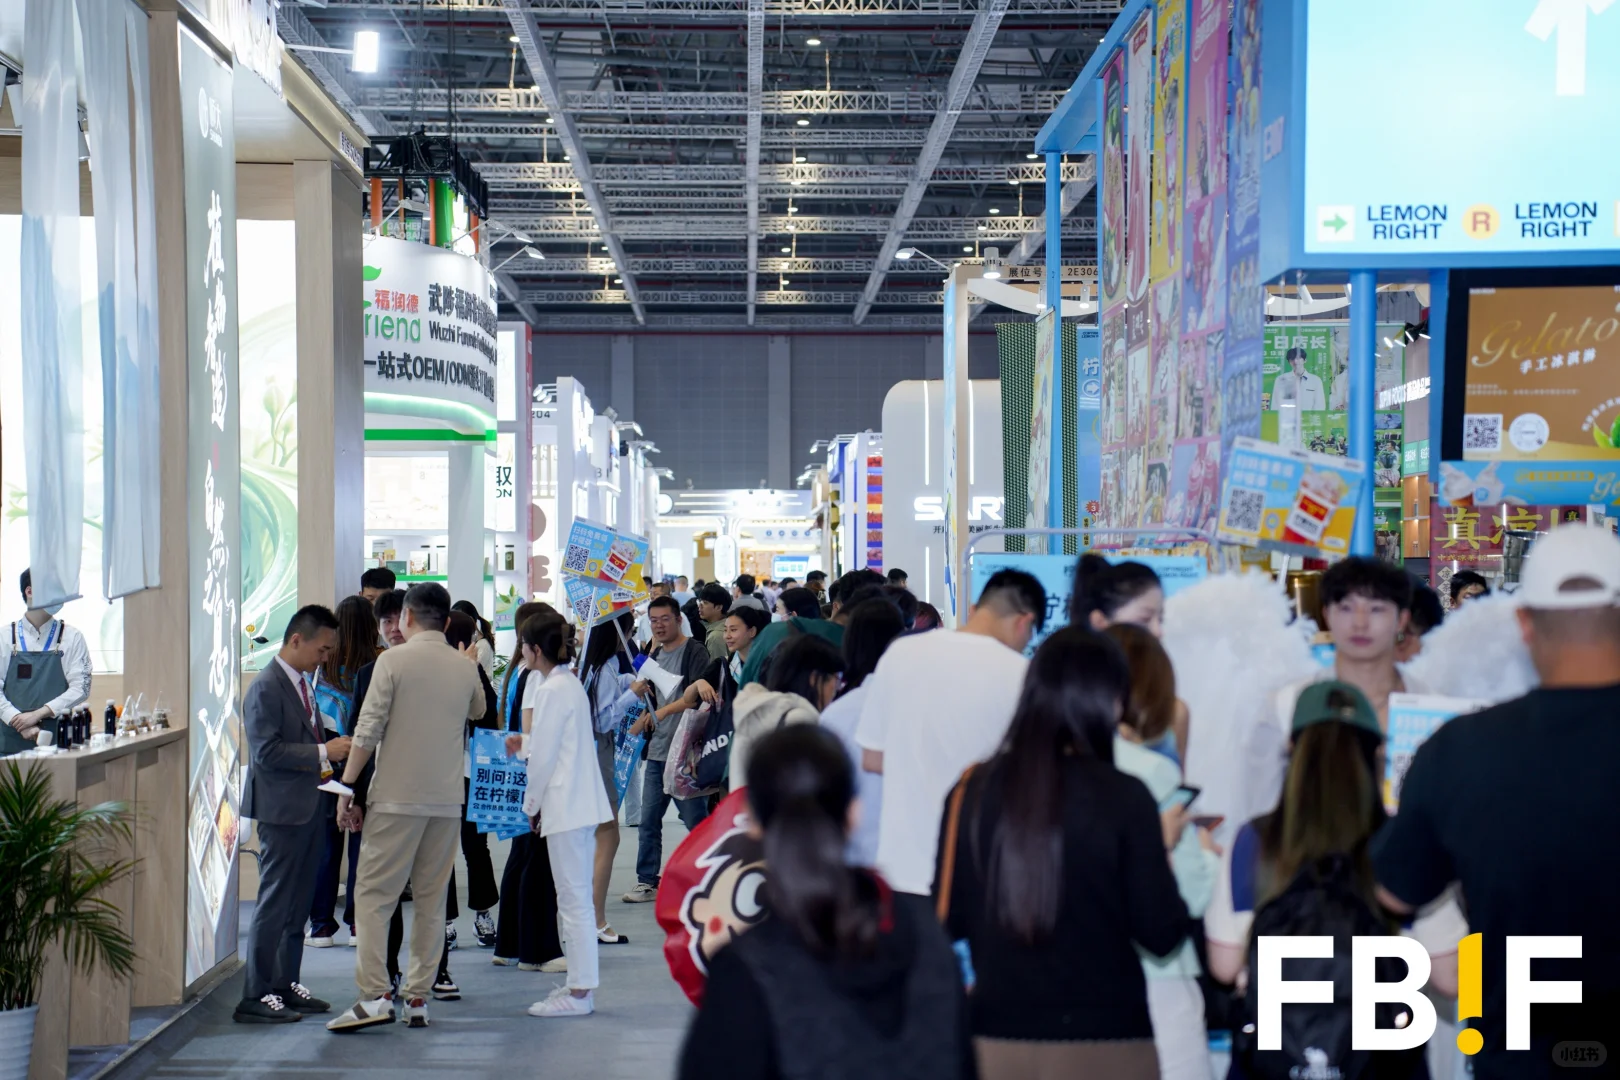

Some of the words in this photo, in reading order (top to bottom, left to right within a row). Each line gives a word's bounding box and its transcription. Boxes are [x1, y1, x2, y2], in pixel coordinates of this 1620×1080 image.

[1367, 204, 1448, 222] LEMON
[1515, 201, 1598, 220] LEMON
[1373, 223, 1443, 240] RIGHT
[1472, 211, 1491, 232] R
[1521, 220, 1592, 238] RIGHT
[1009, 267, 1042, 278] 展位号
[1067, 267, 1098, 276] 2E306
[375, 289, 419, 313] 福润德
[363, 313, 421, 342] riend
[429, 321, 456, 343] Wuzhi
[1471, 312, 1619, 367] Gelato
